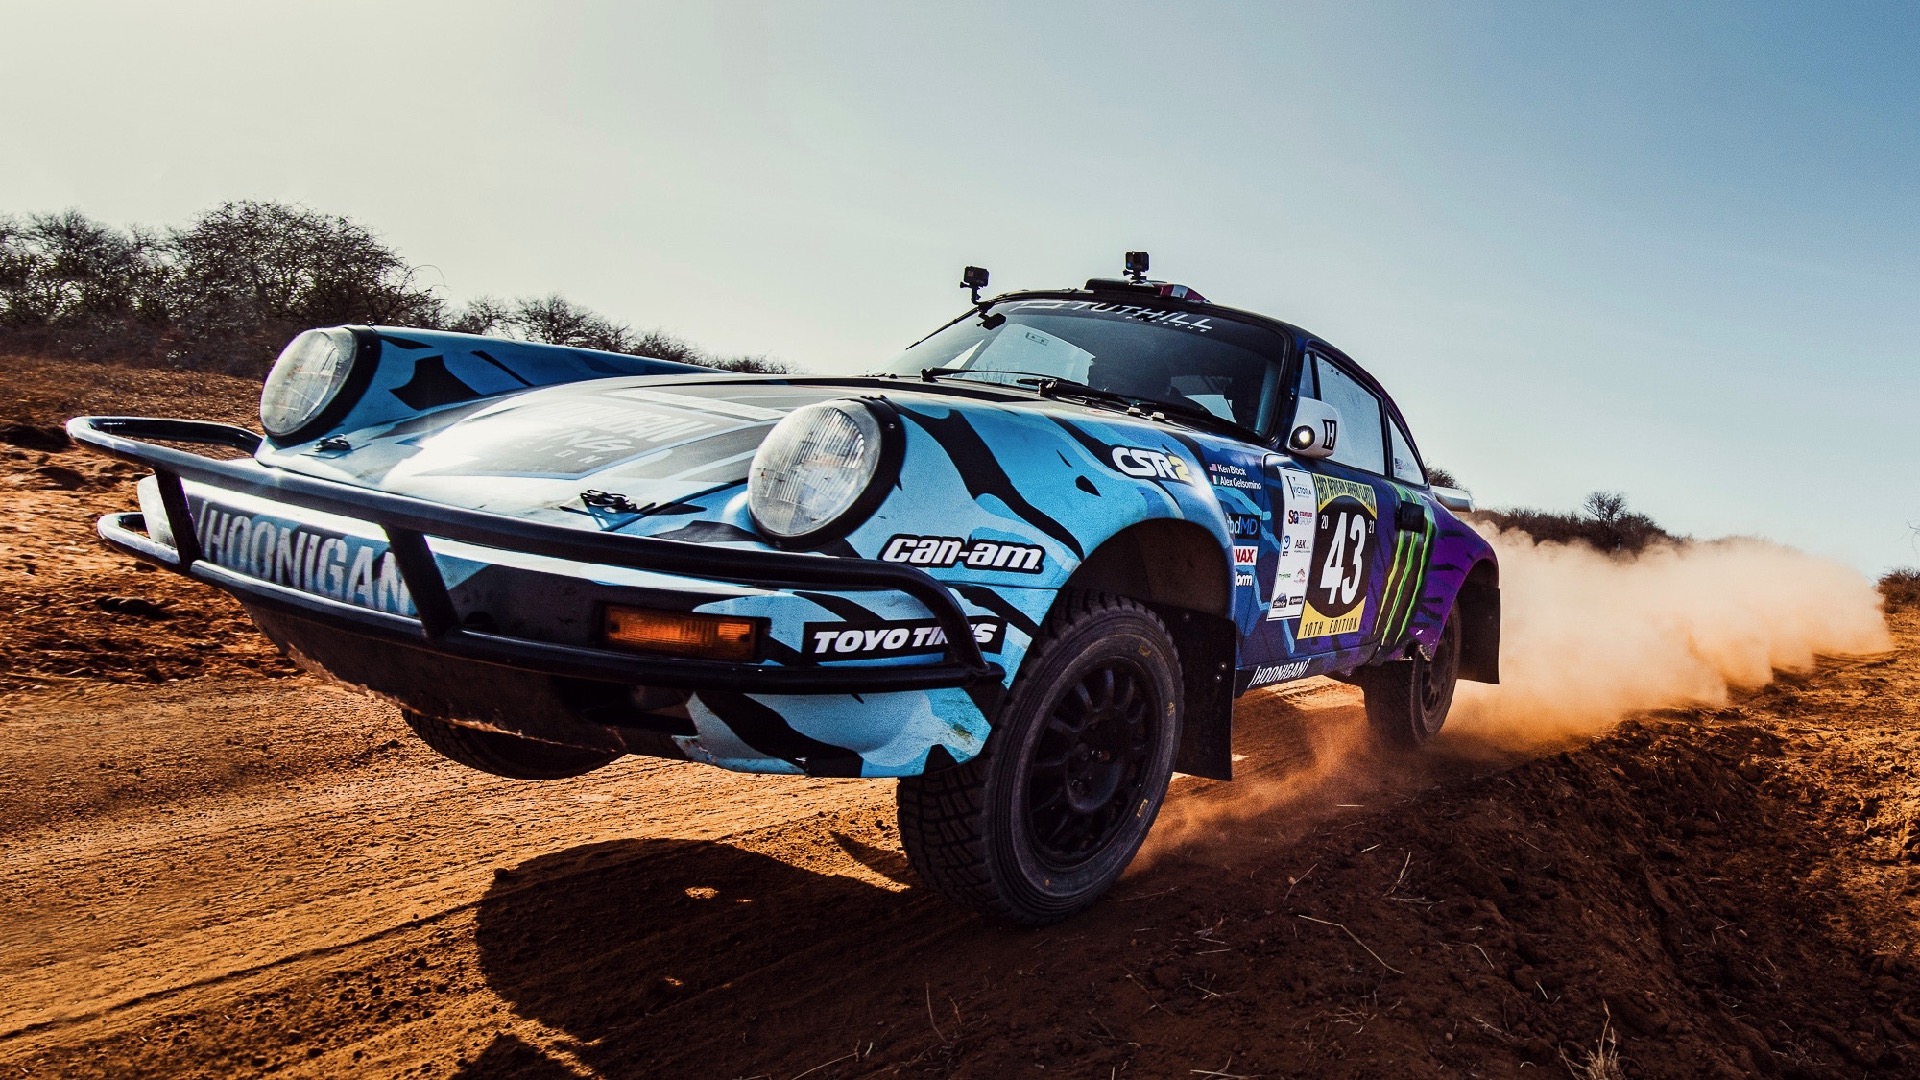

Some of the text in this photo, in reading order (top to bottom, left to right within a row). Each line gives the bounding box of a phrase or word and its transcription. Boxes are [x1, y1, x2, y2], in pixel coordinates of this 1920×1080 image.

[1072, 302, 1213, 330] TUTHILL
[1112, 446, 1194, 484] CSR2
[1217, 464, 1247, 476] Ken Block
[1220, 475, 1262, 490] Alex Gelsomino
[1288, 509, 1299, 525] SG
[1320, 513, 1329, 530] 20
[1368, 519, 1375, 534] 21
[882, 537, 1040, 570] can-am
[1320, 511, 1366, 605] 43
[1303, 616, 1358, 637] 10TH EDITION
[813, 627, 910, 654] TOYO
